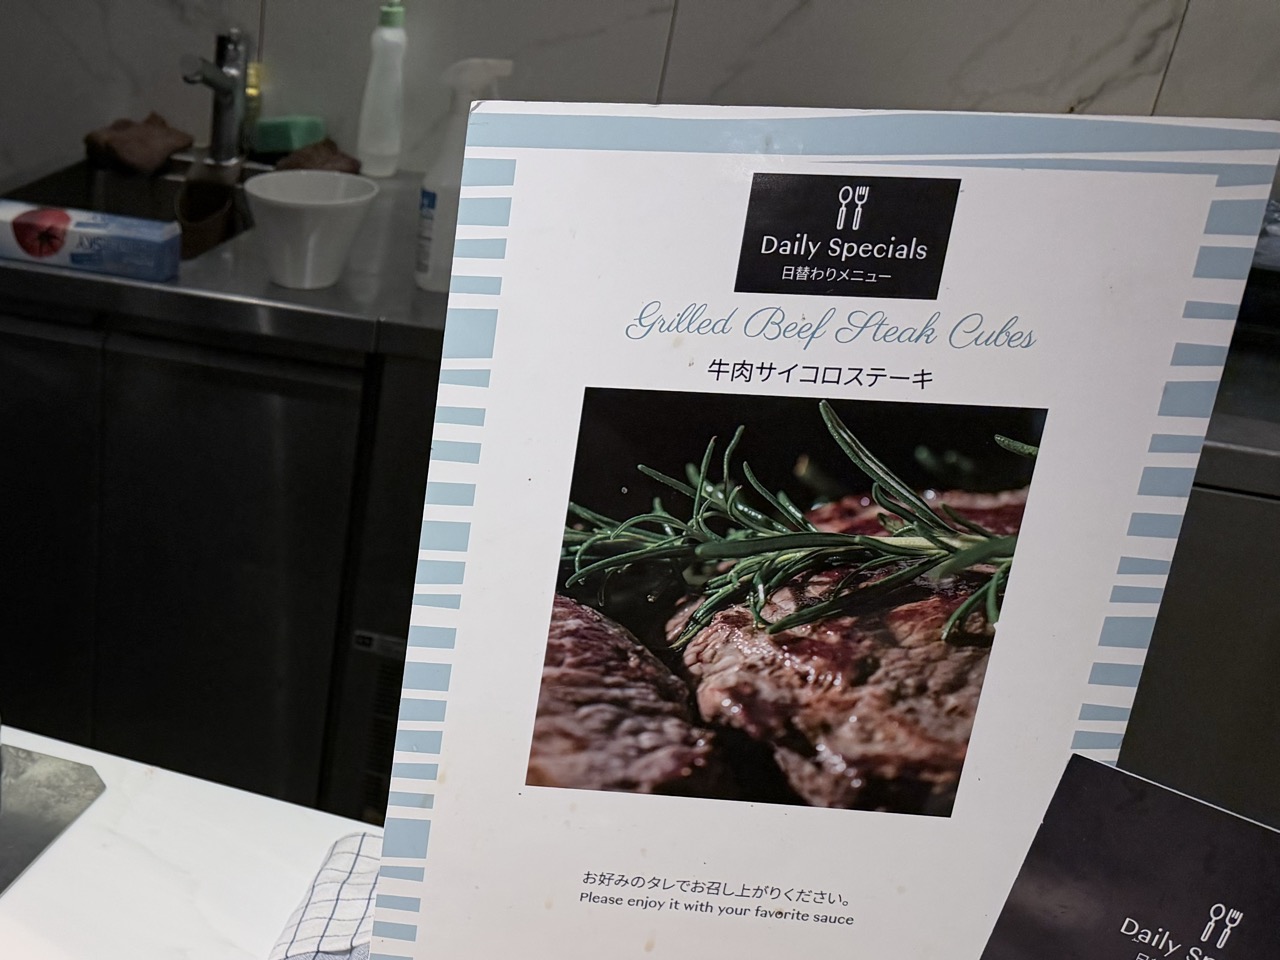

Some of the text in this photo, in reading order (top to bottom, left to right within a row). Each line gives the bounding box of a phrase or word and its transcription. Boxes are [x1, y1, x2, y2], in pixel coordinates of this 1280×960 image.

[760, 233, 928, 262] Daily Specials
[781, 265, 892, 283] 日替わりメニュー
[625, 300, 1037, 350] Grilled Beef Steak Cubes
[707, 358, 934, 390] 牛肉サイコロステーキ
[582, 871, 849, 907] お好みのタレでお召し上がりください。
[579, 892, 854, 926] Please enjoy it with your favorite sauce
[1120, 917, 1182, 957] Daily
